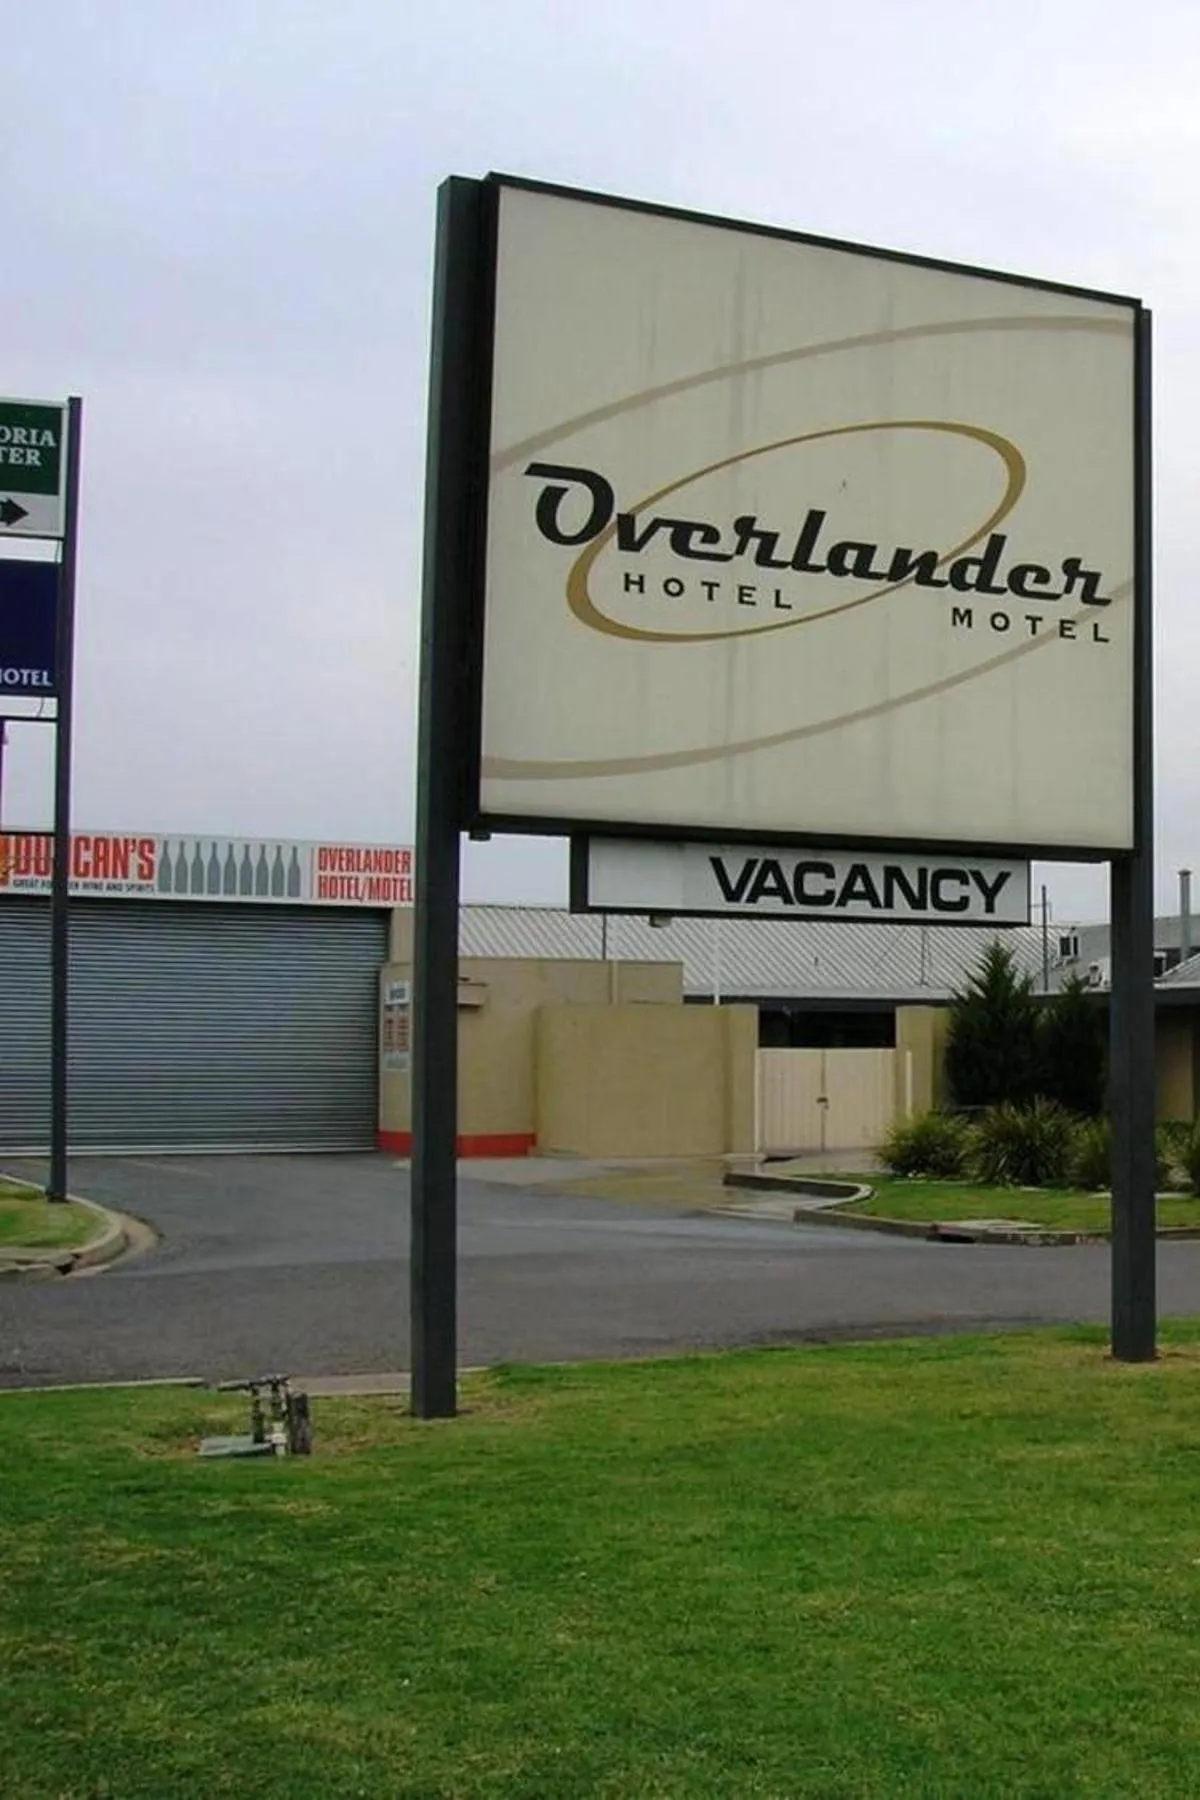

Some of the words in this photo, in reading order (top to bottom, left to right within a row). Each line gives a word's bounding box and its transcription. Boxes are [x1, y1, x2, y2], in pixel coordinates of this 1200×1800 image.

[524, 462, 1112, 606] Overlander
[623, 572, 792, 609] HOTEL
[952, 607, 1110, 643] MOTEL
[0, 668, 53, 687] OTEL
[15, 834, 156, 880] DUCAN'S
[318, 847, 411, 873] OVERLANDER
[318, 875, 413, 902] HOTEL/MOTEL
[709, 856, 1012, 914] VACANCY
